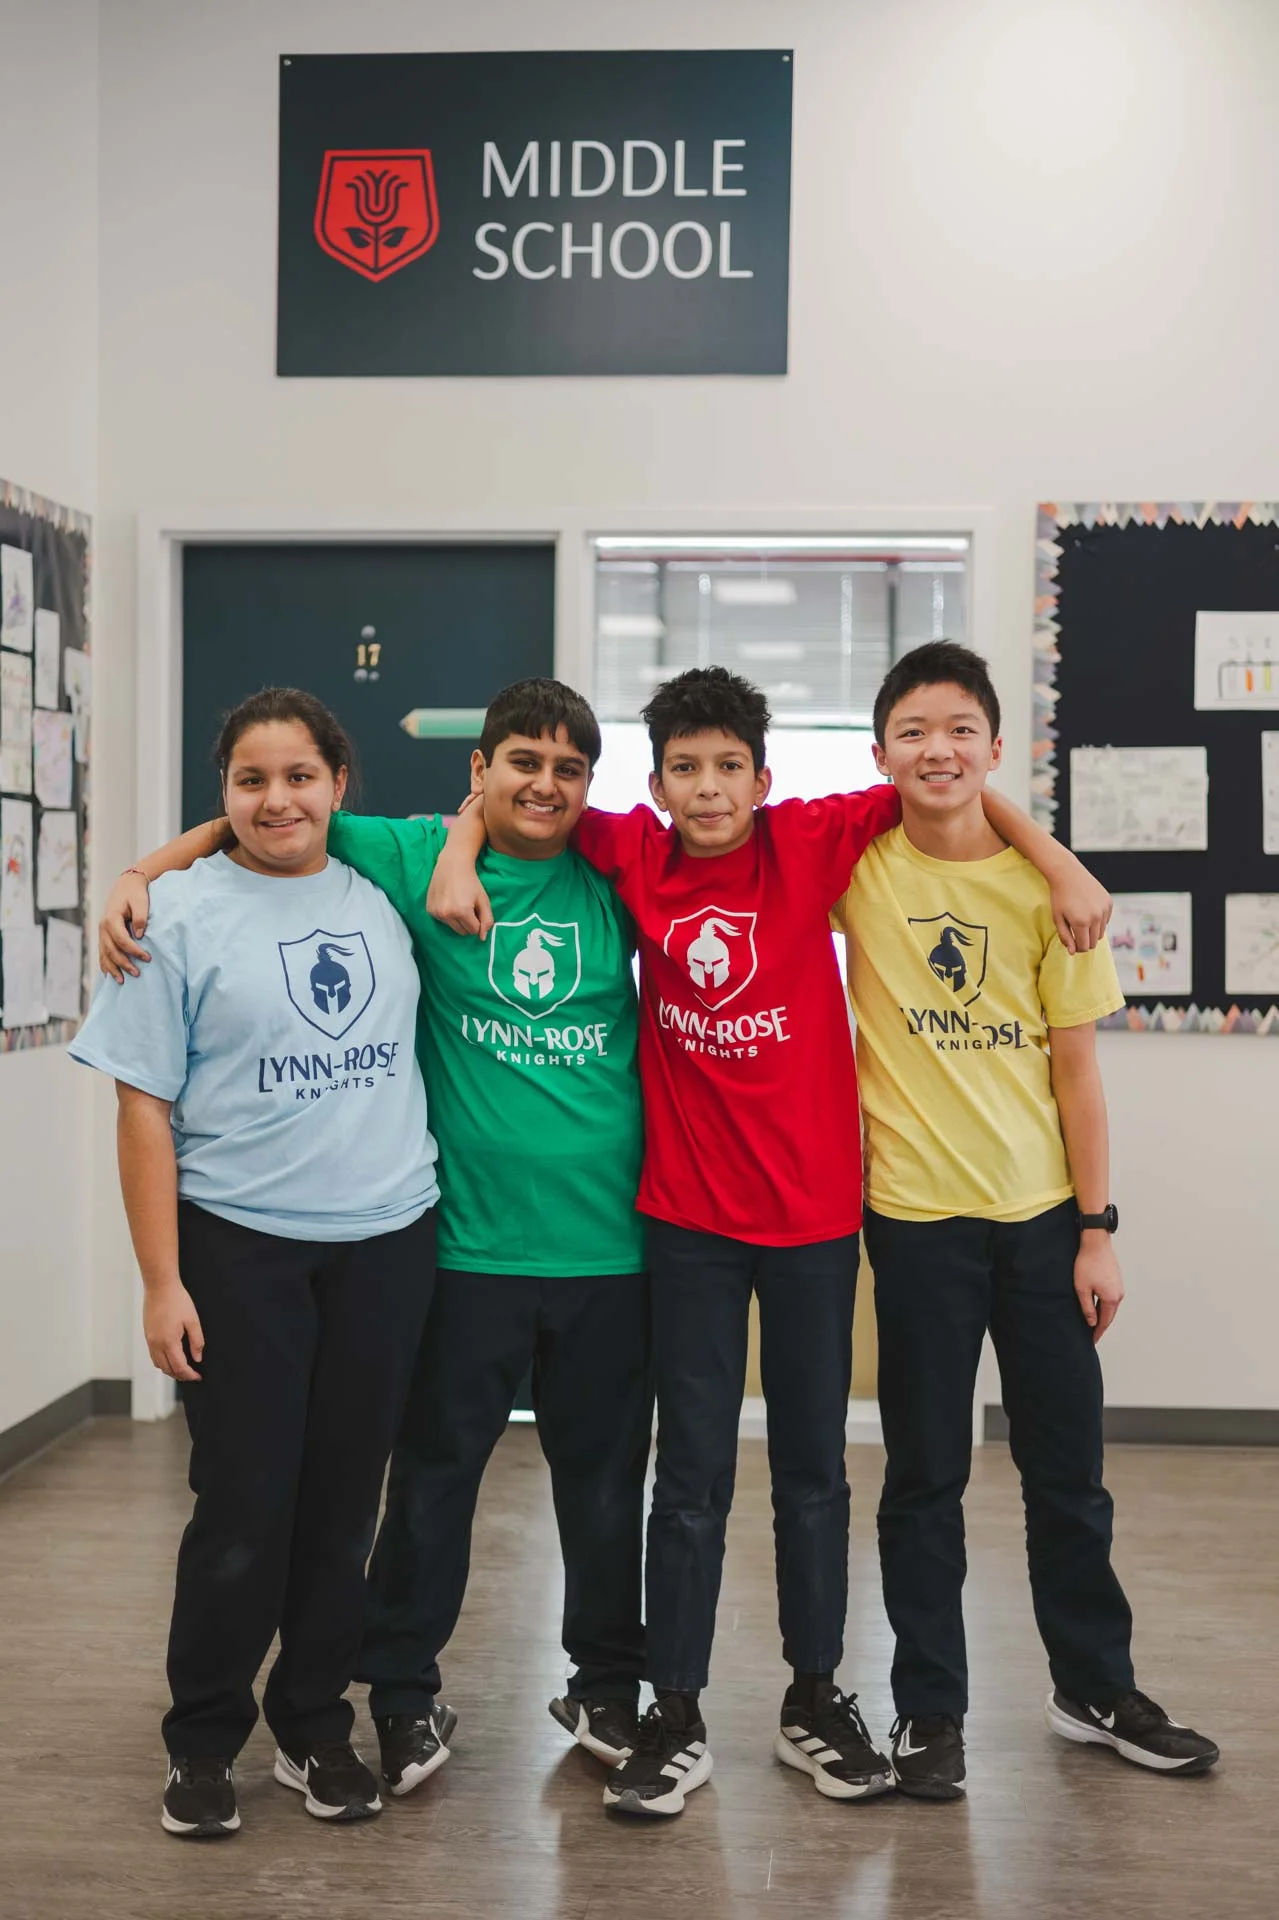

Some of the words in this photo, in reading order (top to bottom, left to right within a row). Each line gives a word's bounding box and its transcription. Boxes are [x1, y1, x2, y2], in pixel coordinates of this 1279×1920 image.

[482, 139, 747, 198] MIDDLE
[472, 221, 754, 280] SCHOOL
[356, 643, 381, 667] 17
[461, 1014, 608, 1057] LYNN-ROSE
[659, 996, 791, 1044] LYNN-ROSE
[900, 1007, 1028, 1049] LYNN-OSE
[496, 1049, 586, 1067] KNIGHTS
[936, 1039, 997, 1051] KNIGH
[258, 1042, 399, 1093] LYNN-ROSE
[296, 1076, 375, 1100] KNGHTS
